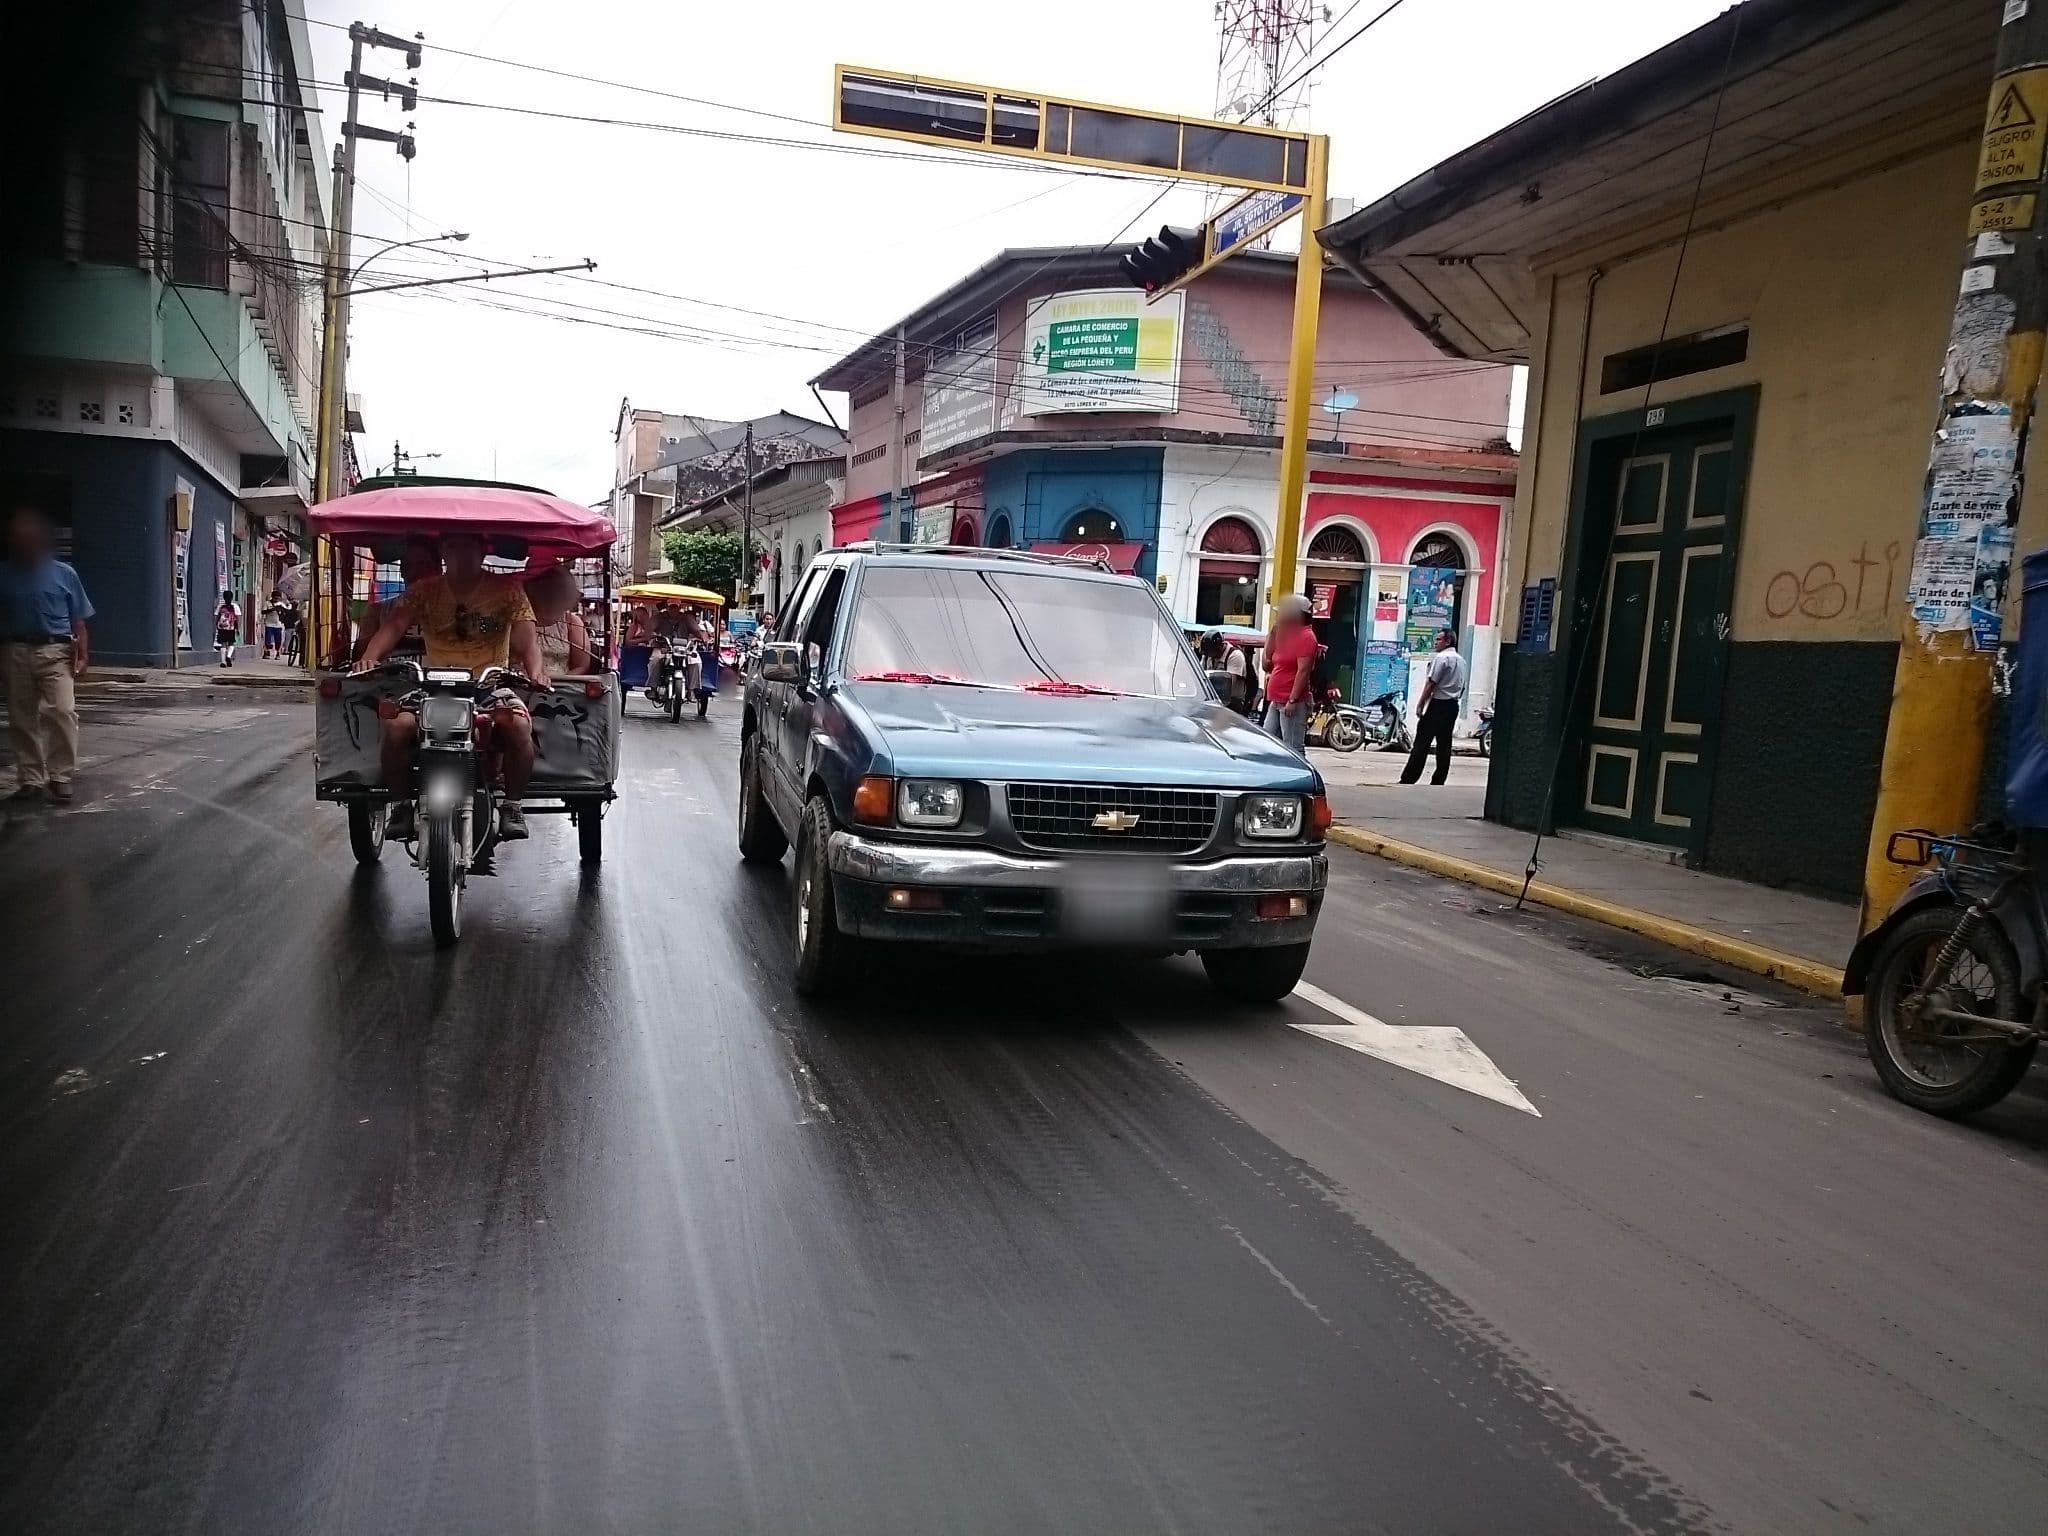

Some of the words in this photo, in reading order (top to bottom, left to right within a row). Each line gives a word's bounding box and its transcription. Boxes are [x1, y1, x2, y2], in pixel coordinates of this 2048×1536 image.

[1987, 149, 2016, 163] ALTA
[1092, 322, 1128, 331] COMERCIO
[1113, 334, 1119, 342] Y
[1069, 347, 1098, 356] EMPRESA
[1100, 347, 1113, 355] DEL
[1087, 357, 1114, 367] LORETO
[1940, 502, 1961, 511] arte
[1963, 500, 1977, 510] de
[1979, 500, 2002, 510] vivir
[1936, 511, 1955, 520] con
[1957, 510, 1993, 521] coraje
[1928, 588, 1948, 598] arte
[1950, 588, 1964, 598] de
